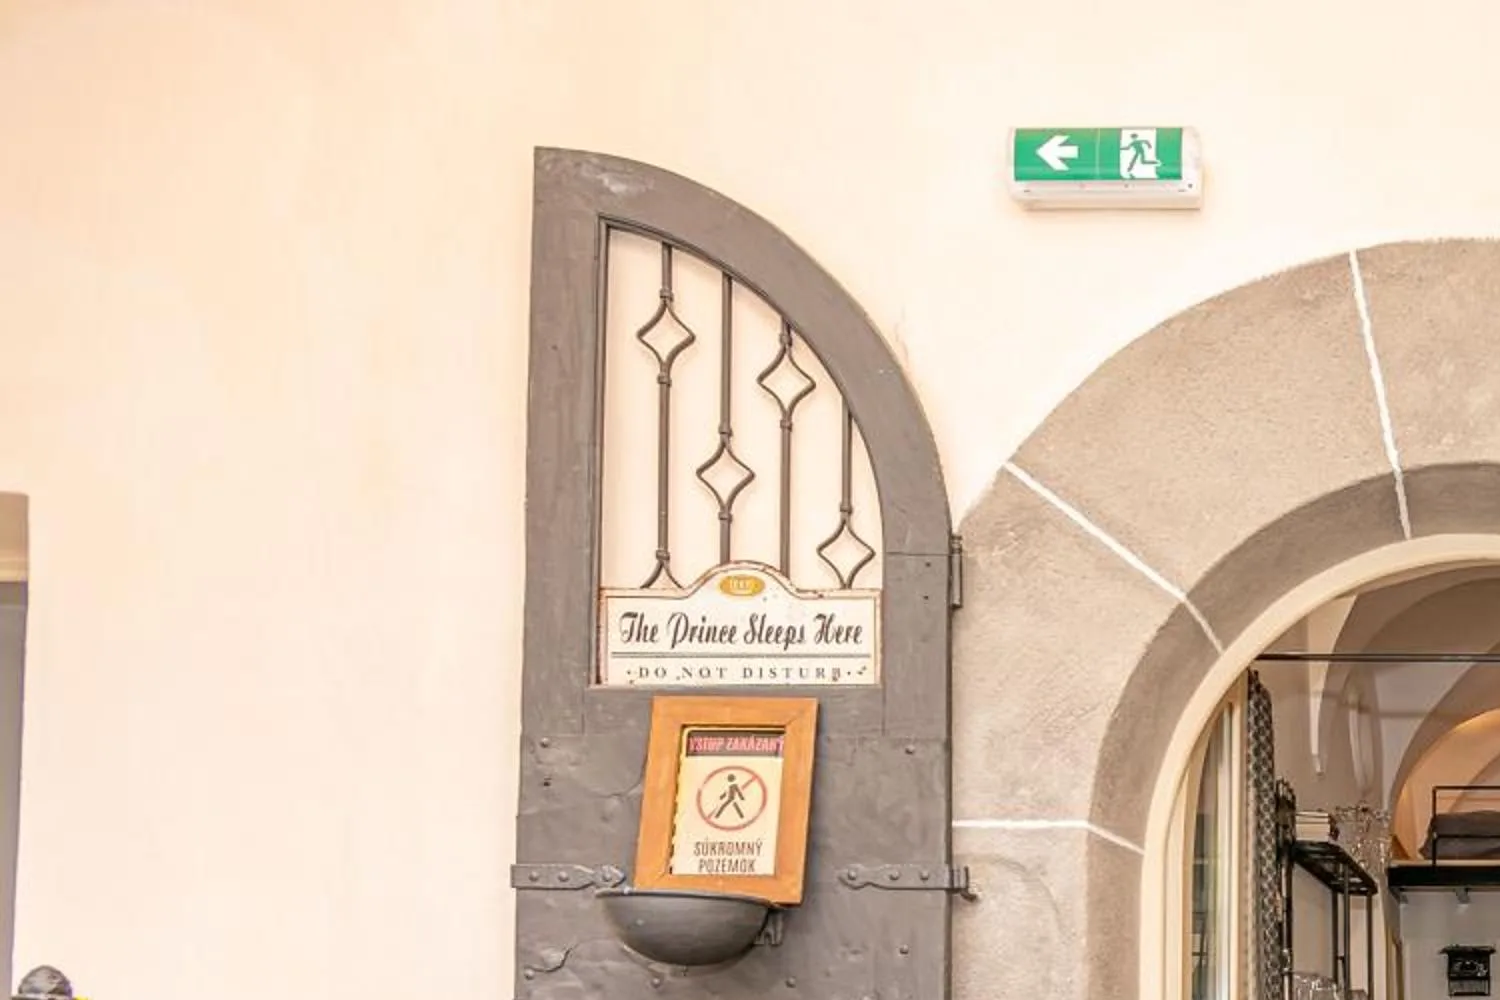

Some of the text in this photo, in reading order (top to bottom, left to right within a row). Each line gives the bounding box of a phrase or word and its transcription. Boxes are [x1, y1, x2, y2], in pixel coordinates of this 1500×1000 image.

[618, 611, 863, 650] The Prince Sleeps Here
[639, 667, 841, 680] DO NOT DISTURB
[689, 737, 725, 752] VSTUP
[699, 858, 756, 873] POZEMOK
